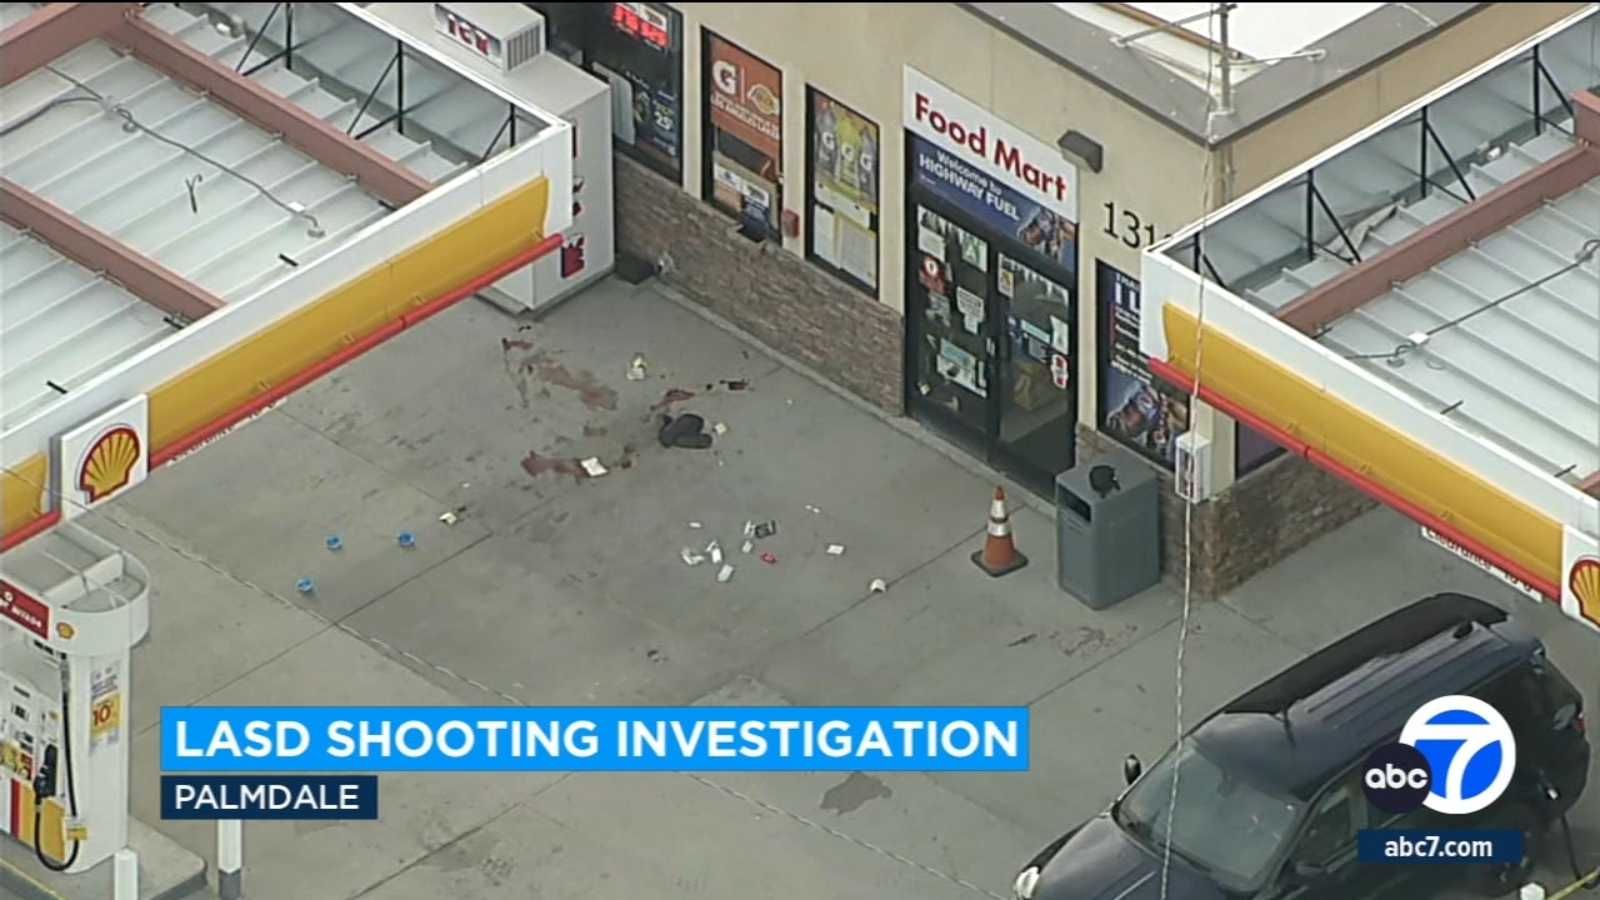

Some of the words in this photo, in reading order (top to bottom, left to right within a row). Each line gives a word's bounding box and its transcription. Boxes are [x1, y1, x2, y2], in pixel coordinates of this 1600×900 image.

[712, 60, 736, 95] G
[914, 92, 986, 157] Food
[994, 138, 1067, 201] Mart
[937, 150, 988, 188] Welcome
[919, 153, 984, 200] HIGHWAY
[986, 191, 1020, 221] FUEL
[1103, 200, 1172, 249] 131
